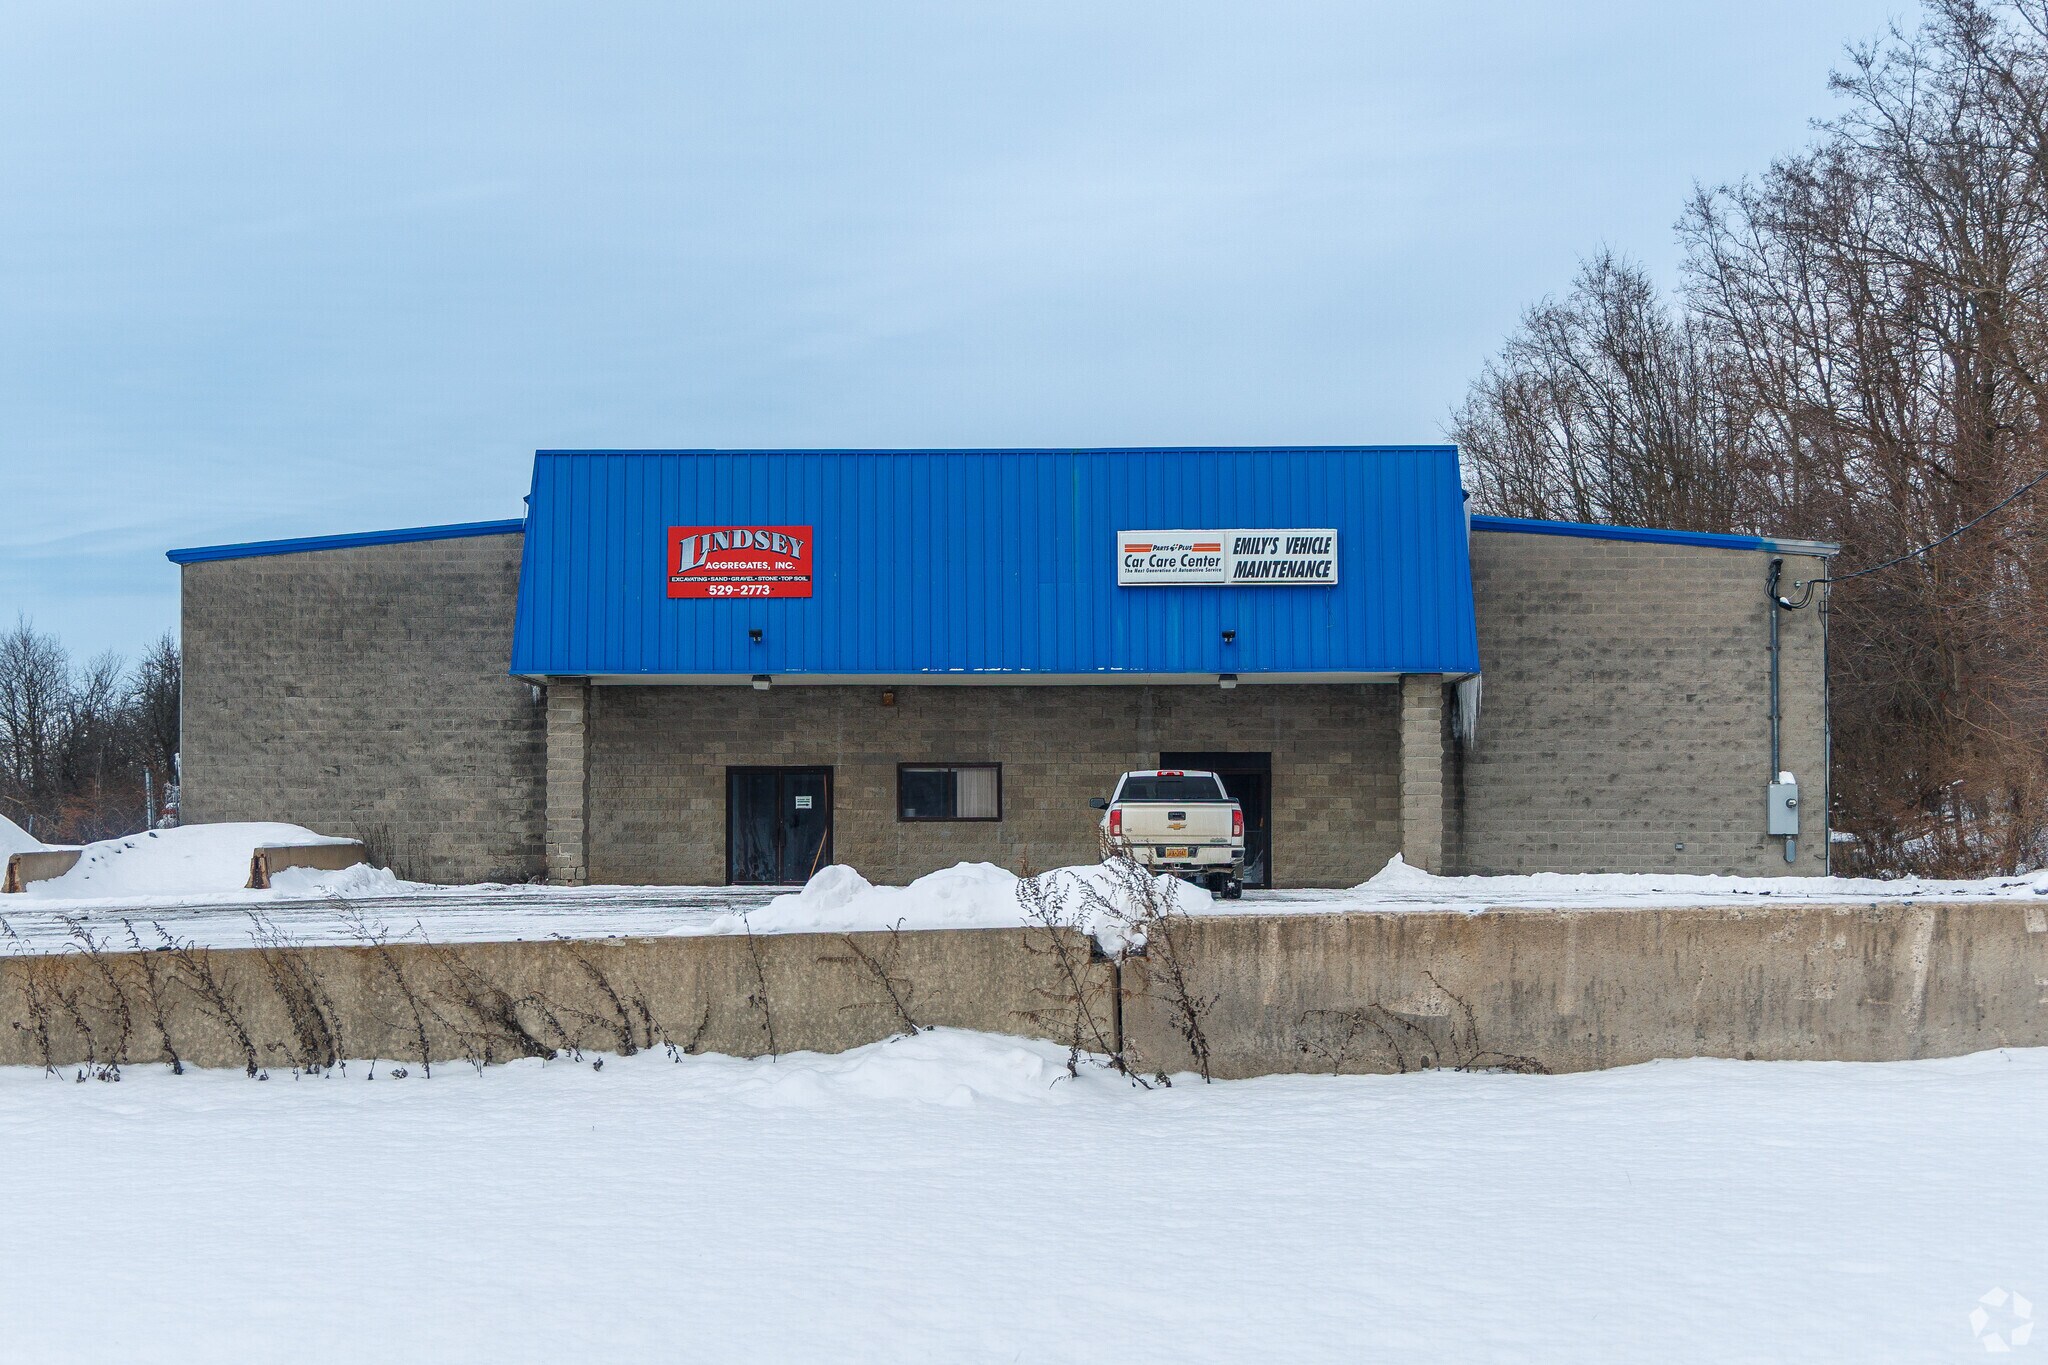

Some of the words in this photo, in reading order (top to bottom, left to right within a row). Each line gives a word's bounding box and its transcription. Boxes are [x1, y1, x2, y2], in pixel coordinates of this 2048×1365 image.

[677, 529, 804, 574] LINDSEY
[1232, 537, 1280, 555] EMILY'S
[1285, 536, 1332, 555] VEHICLE
[705, 561, 771, 571] AGGREGATES,
[775, 561, 796, 570] INC.
[1124, 554, 1145, 568] Car
[1148, 554, 1177, 568] Care
[1180, 553, 1222, 568] Center
[1232, 560, 1332, 579] MAINTENANCE
[708, 585, 770, 596] 529-2773
